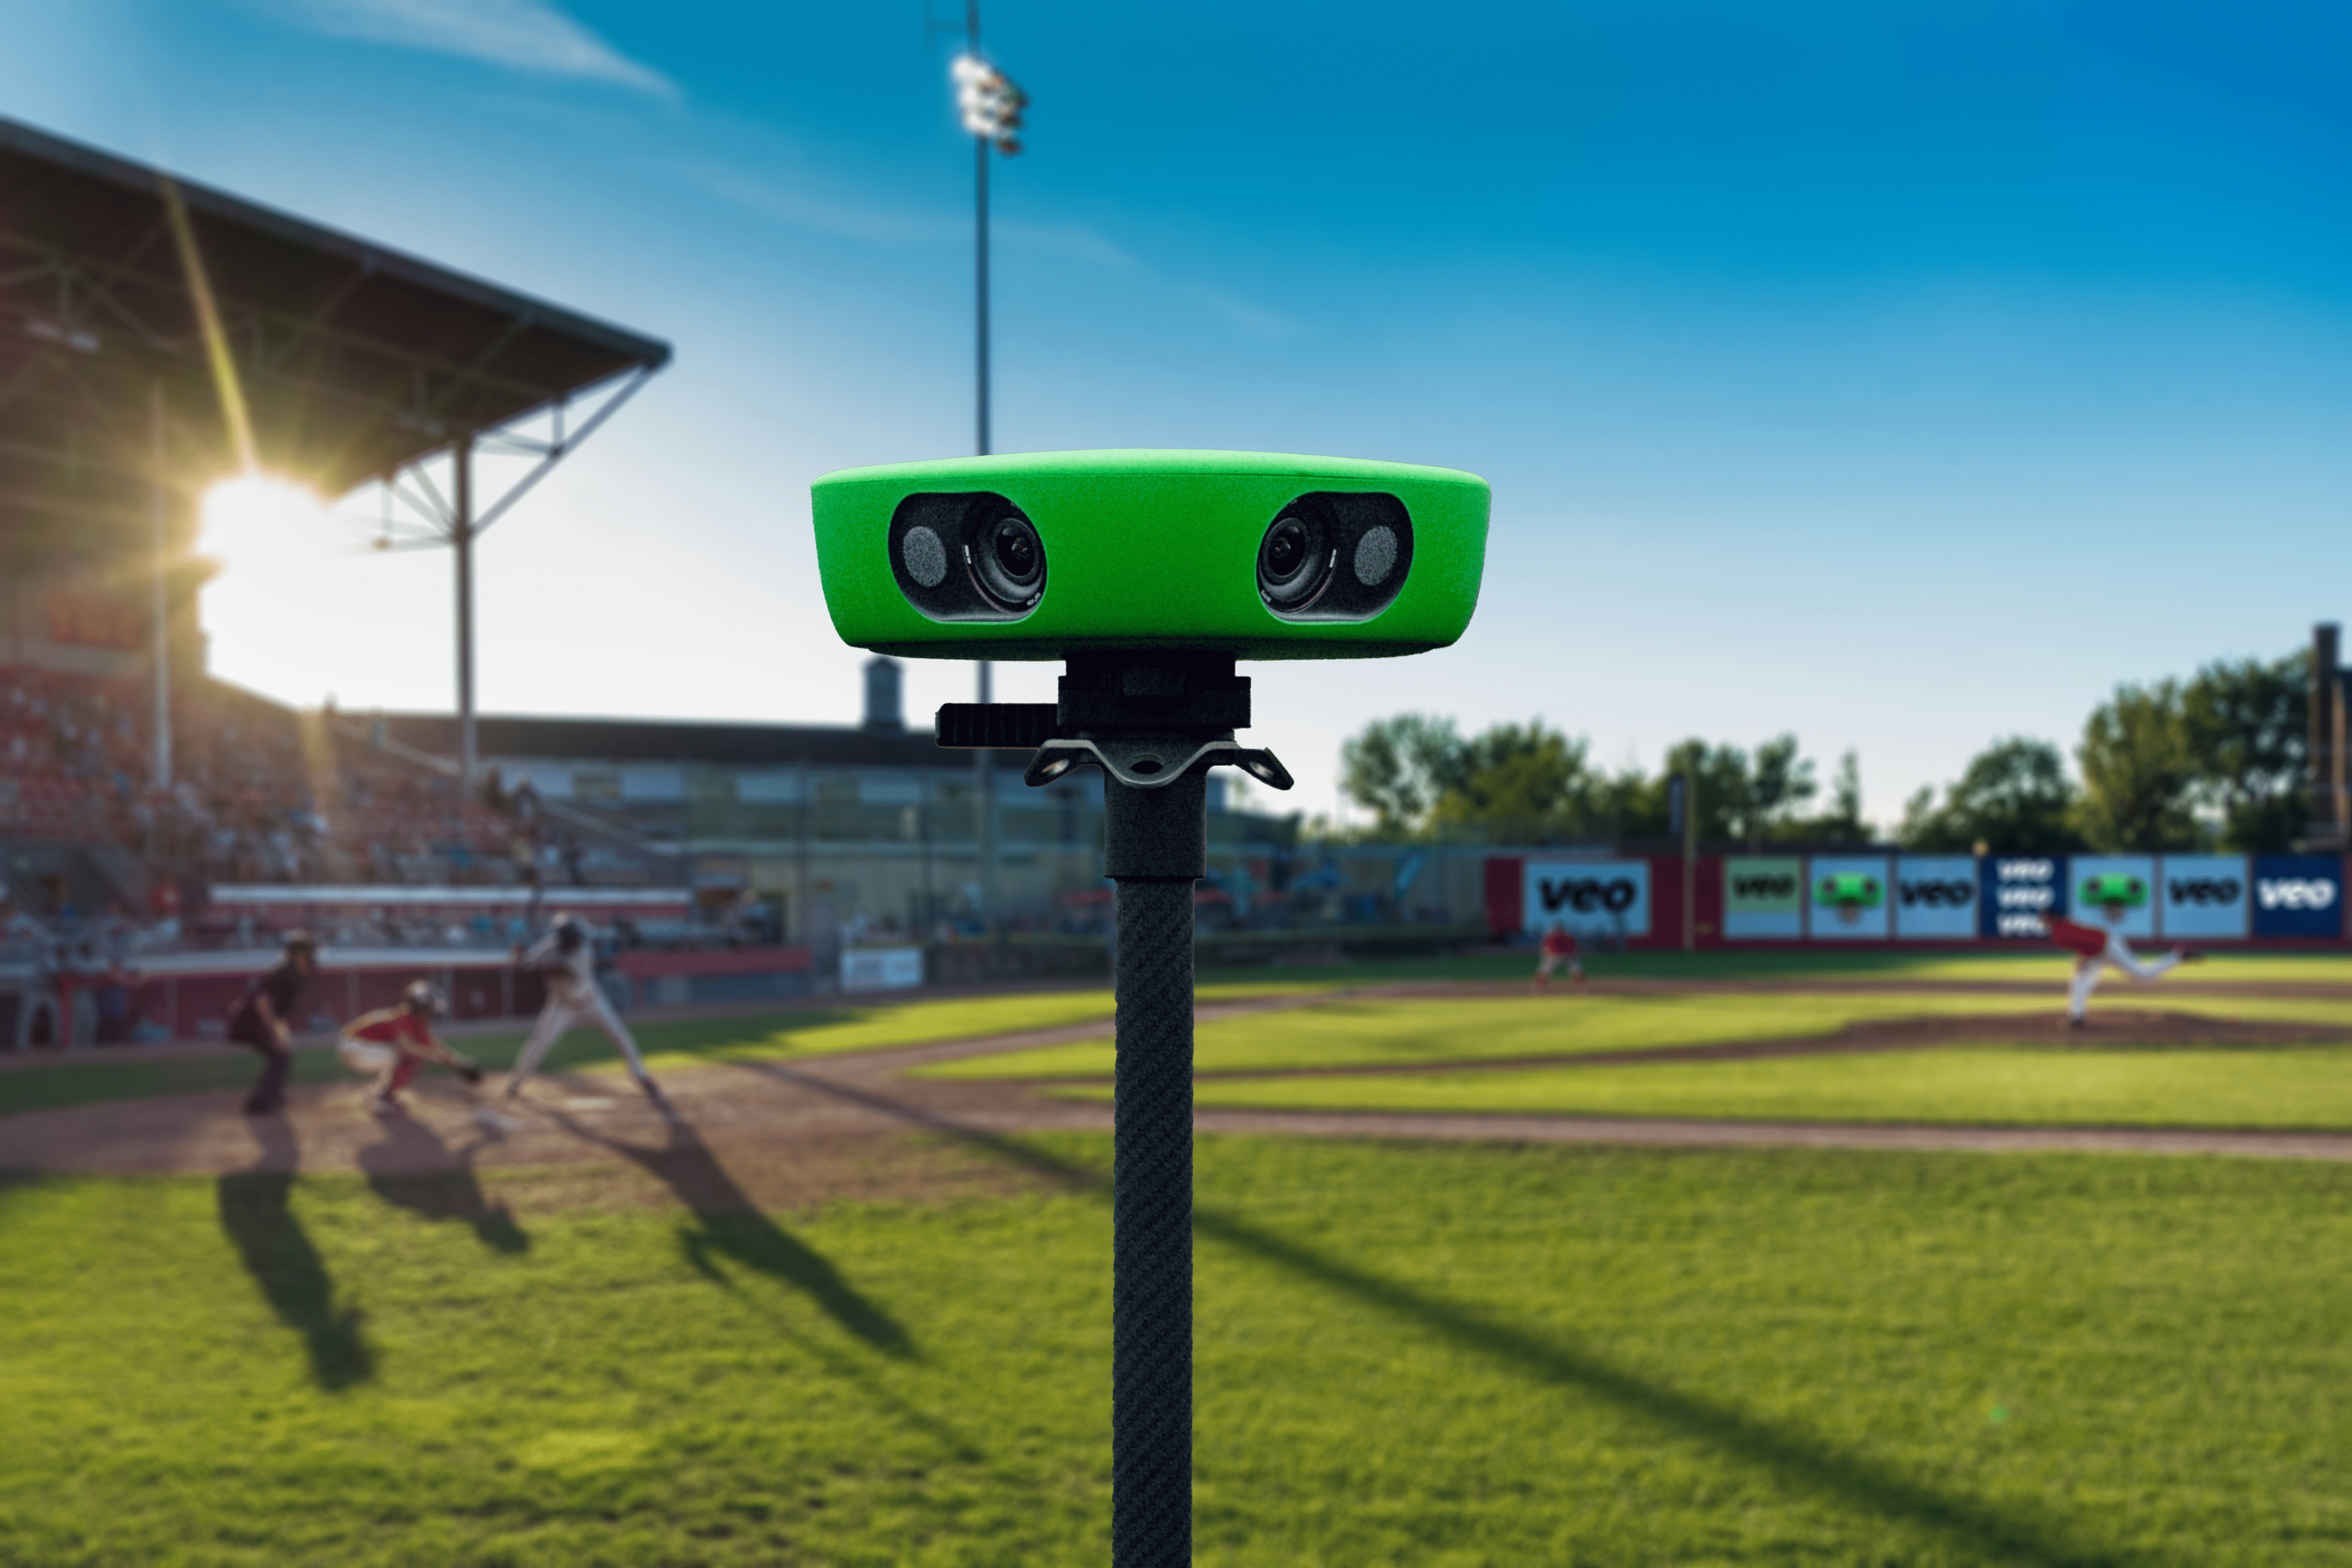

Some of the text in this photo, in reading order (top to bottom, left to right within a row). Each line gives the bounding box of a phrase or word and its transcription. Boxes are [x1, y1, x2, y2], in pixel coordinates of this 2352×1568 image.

[1538, 878, 1637, 913] veo
[1732, 874, 1797, 899] veo
[1900, 879, 1972, 907] veo
[2168, 878, 2240, 905] veo
[2258, 879, 2334, 908] veo
